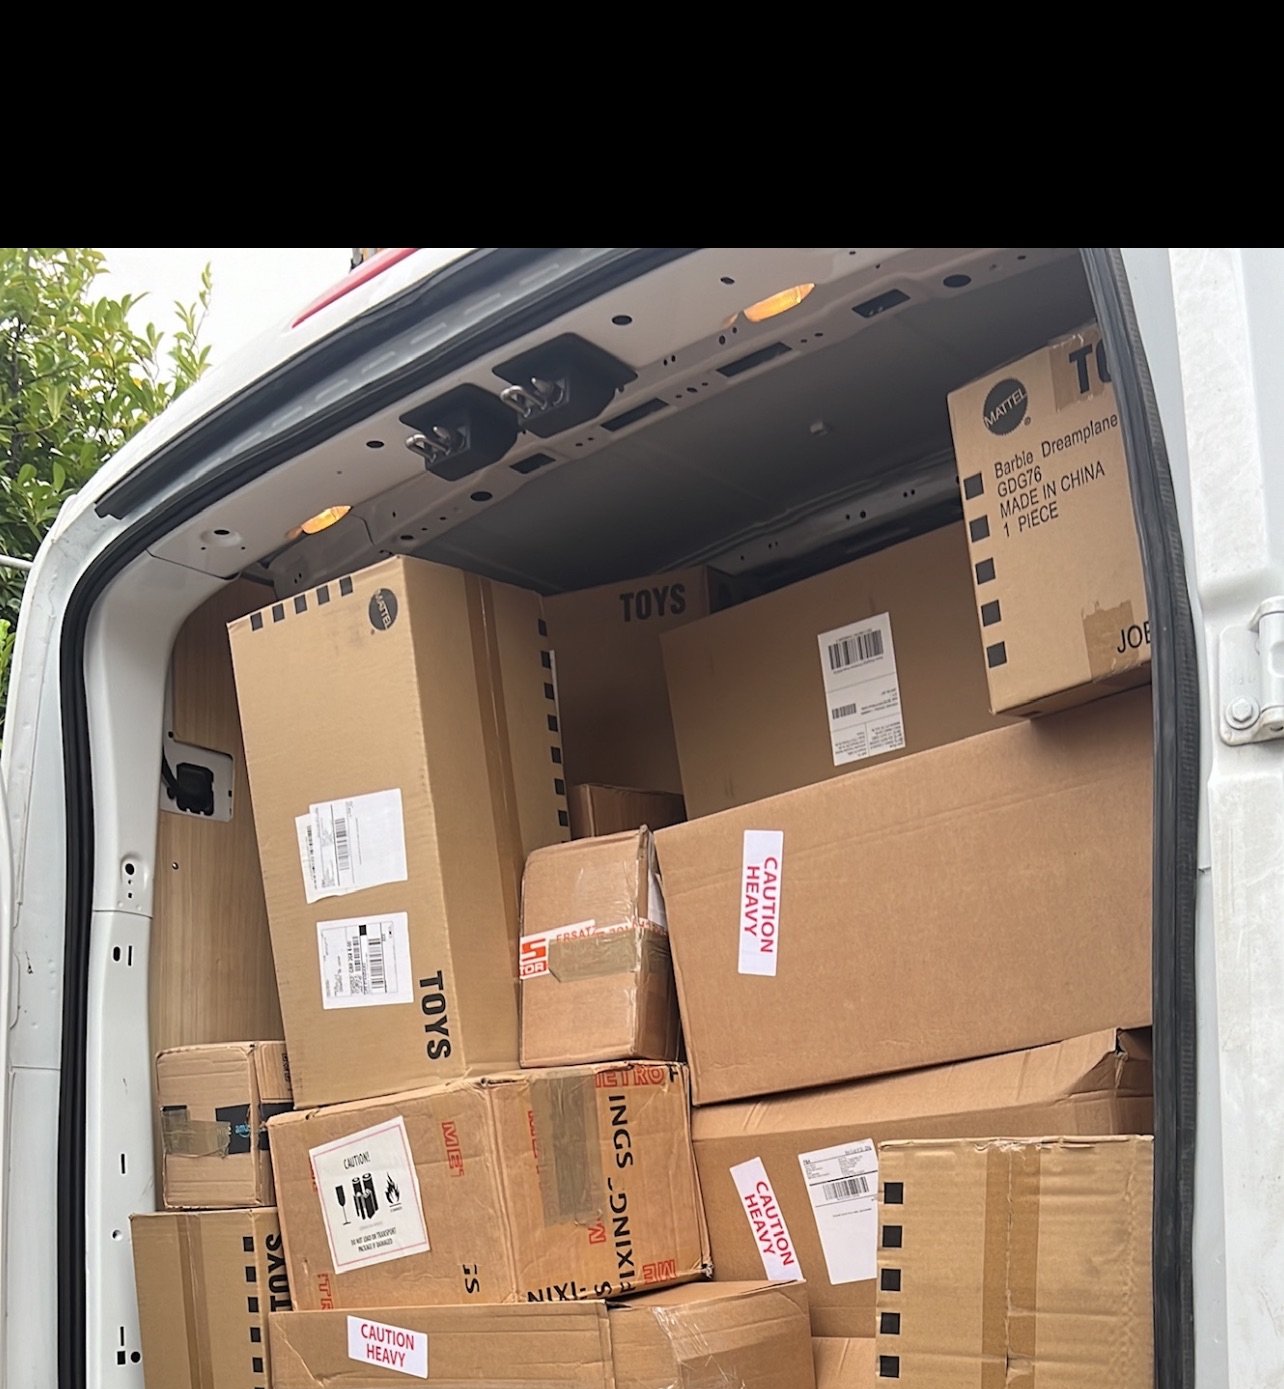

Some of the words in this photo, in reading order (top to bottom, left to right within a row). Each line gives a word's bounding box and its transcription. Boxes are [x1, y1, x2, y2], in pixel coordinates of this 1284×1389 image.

[984, 388, 1027, 427] MATTEL
[994, 450, 1034, 479] Barbie
[1041, 414, 1118, 458] Dreamplane
[997, 465, 1042, 498] GDG76
[1000, 488, 1039, 519] MADE
[1043, 481, 1057, 500] IN
[1060, 461, 1105, 492] CHINA
[1004, 522, 1010, 538] 1
[1018, 501, 1059, 532] PIECE
[620, 583, 686, 622] TOYS
[744, 866, 760, 936] HEAVY
[763, 857, 778, 953] CAUTION
[420, 970, 451, 1059] TOYS
[744, 1193, 776, 1254] HEAVY
[756, 1181, 795, 1266] CAUTION
[361, 1324, 415, 1350] CAUTION
[366, 1343, 405, 1367] HEAVY
